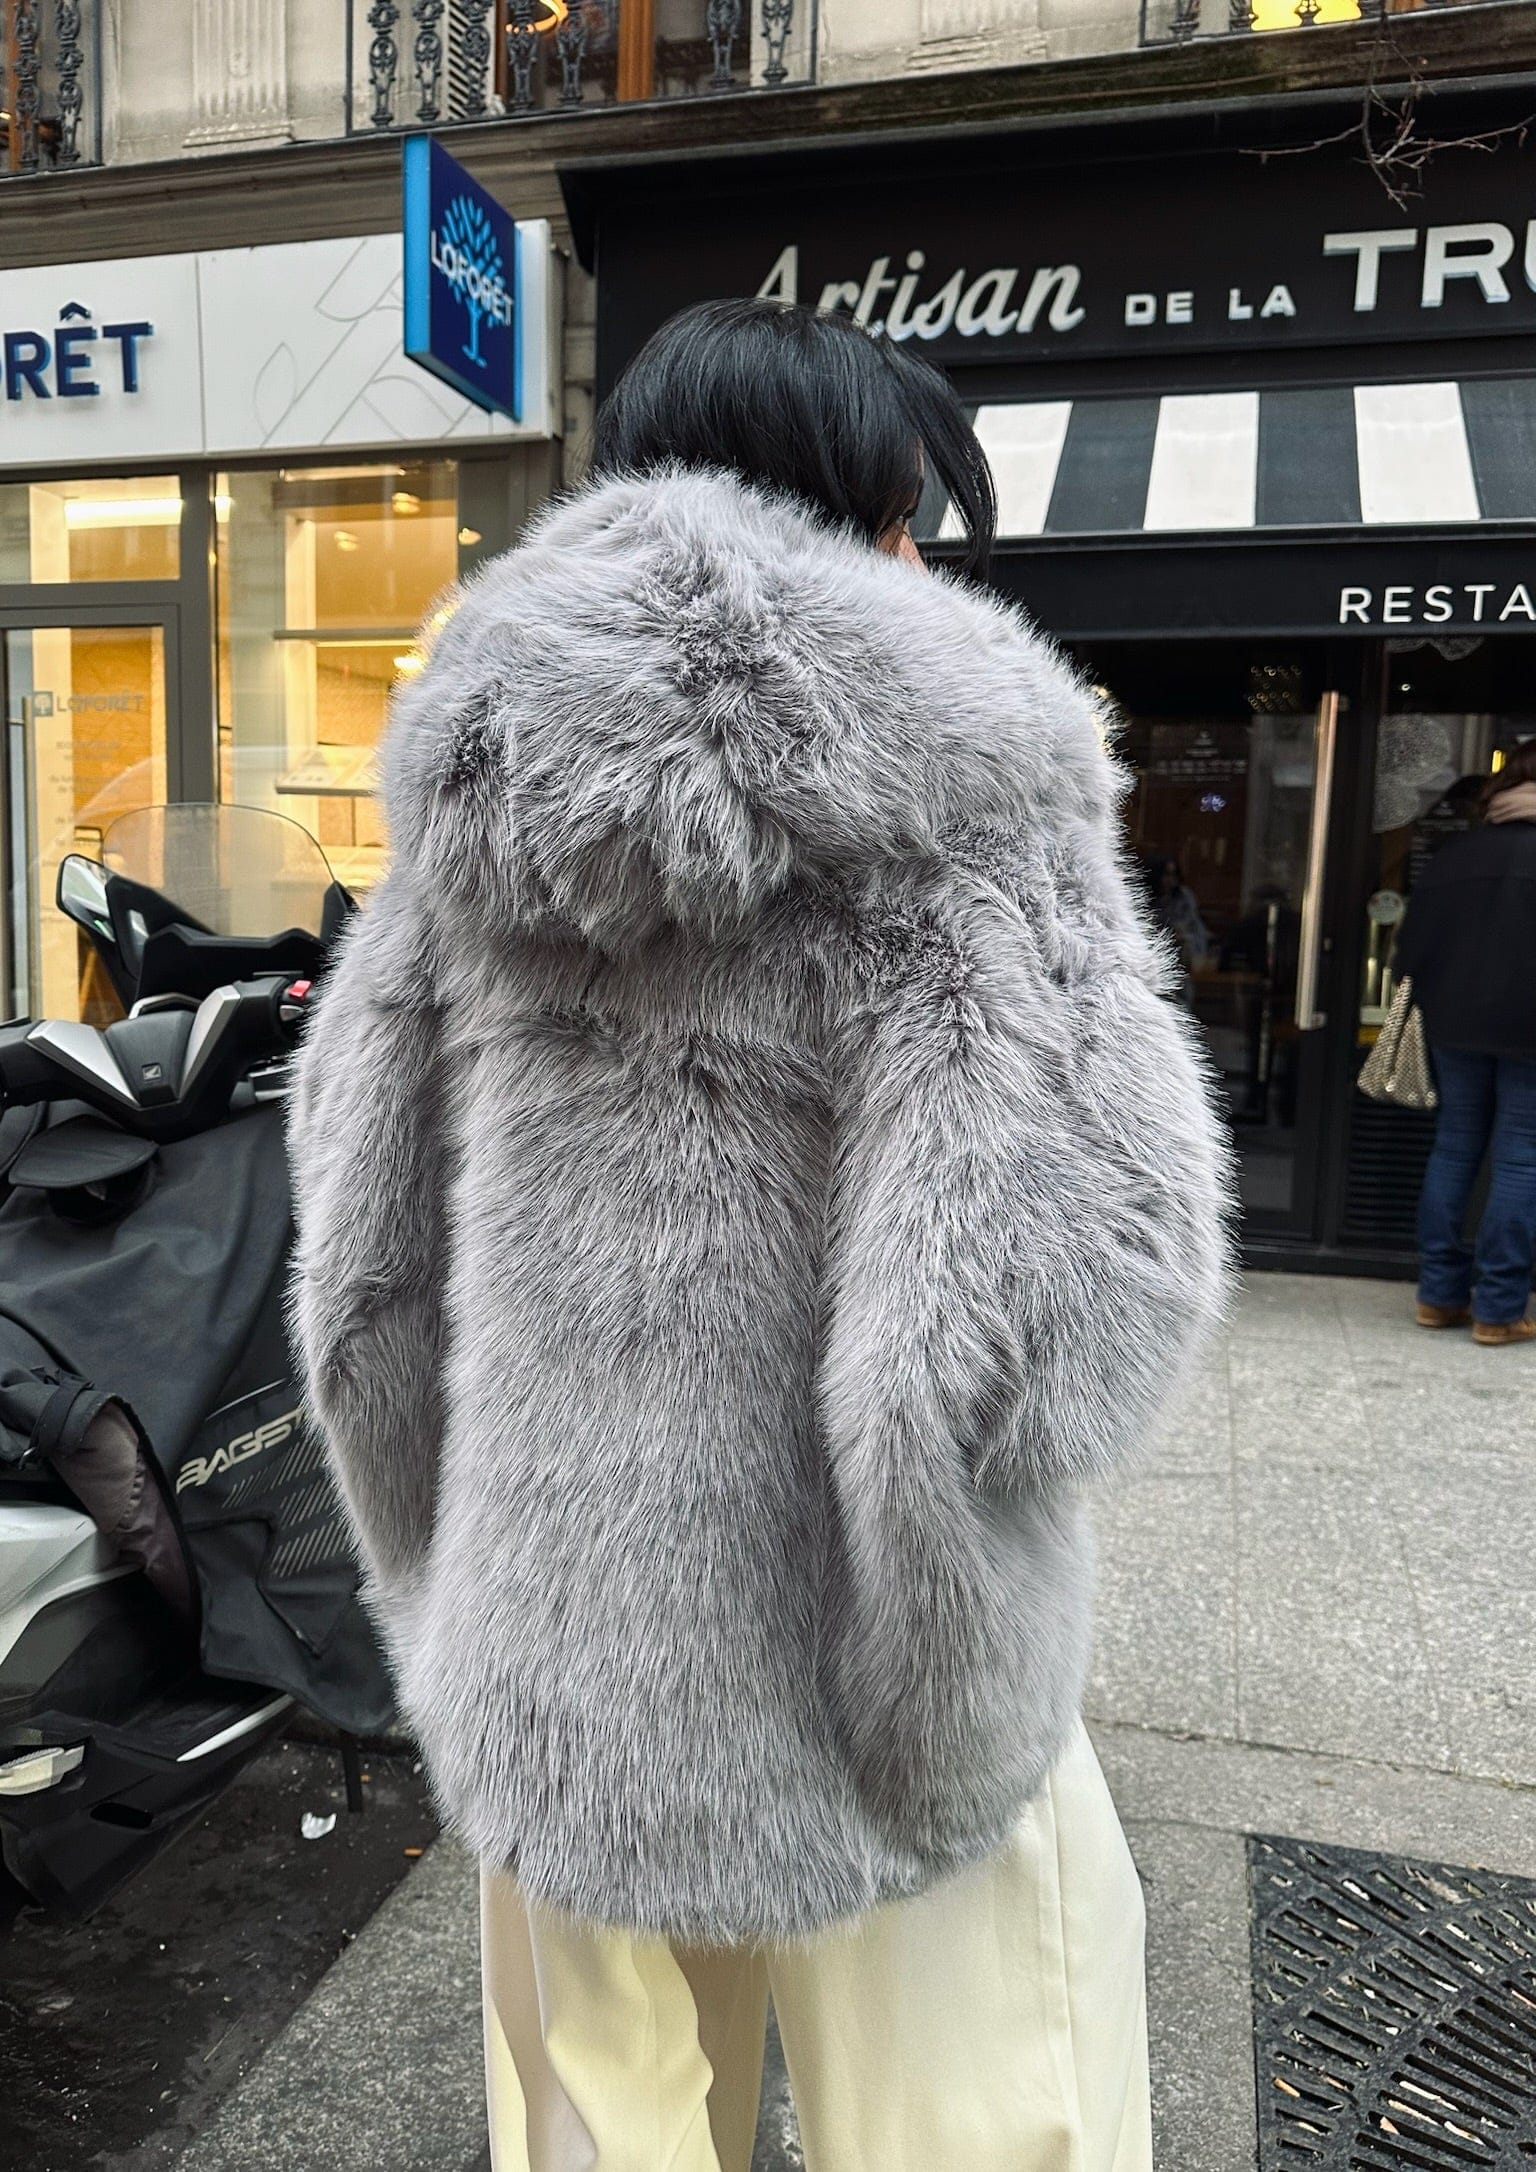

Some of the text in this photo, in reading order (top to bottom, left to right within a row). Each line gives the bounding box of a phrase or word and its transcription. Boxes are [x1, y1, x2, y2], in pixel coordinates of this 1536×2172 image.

[756, 219, 1536, 341] Artisan DE LA TR
[0, 301, 154, 401] RÊT
[1339, 584, 1536, 624] RESTA
